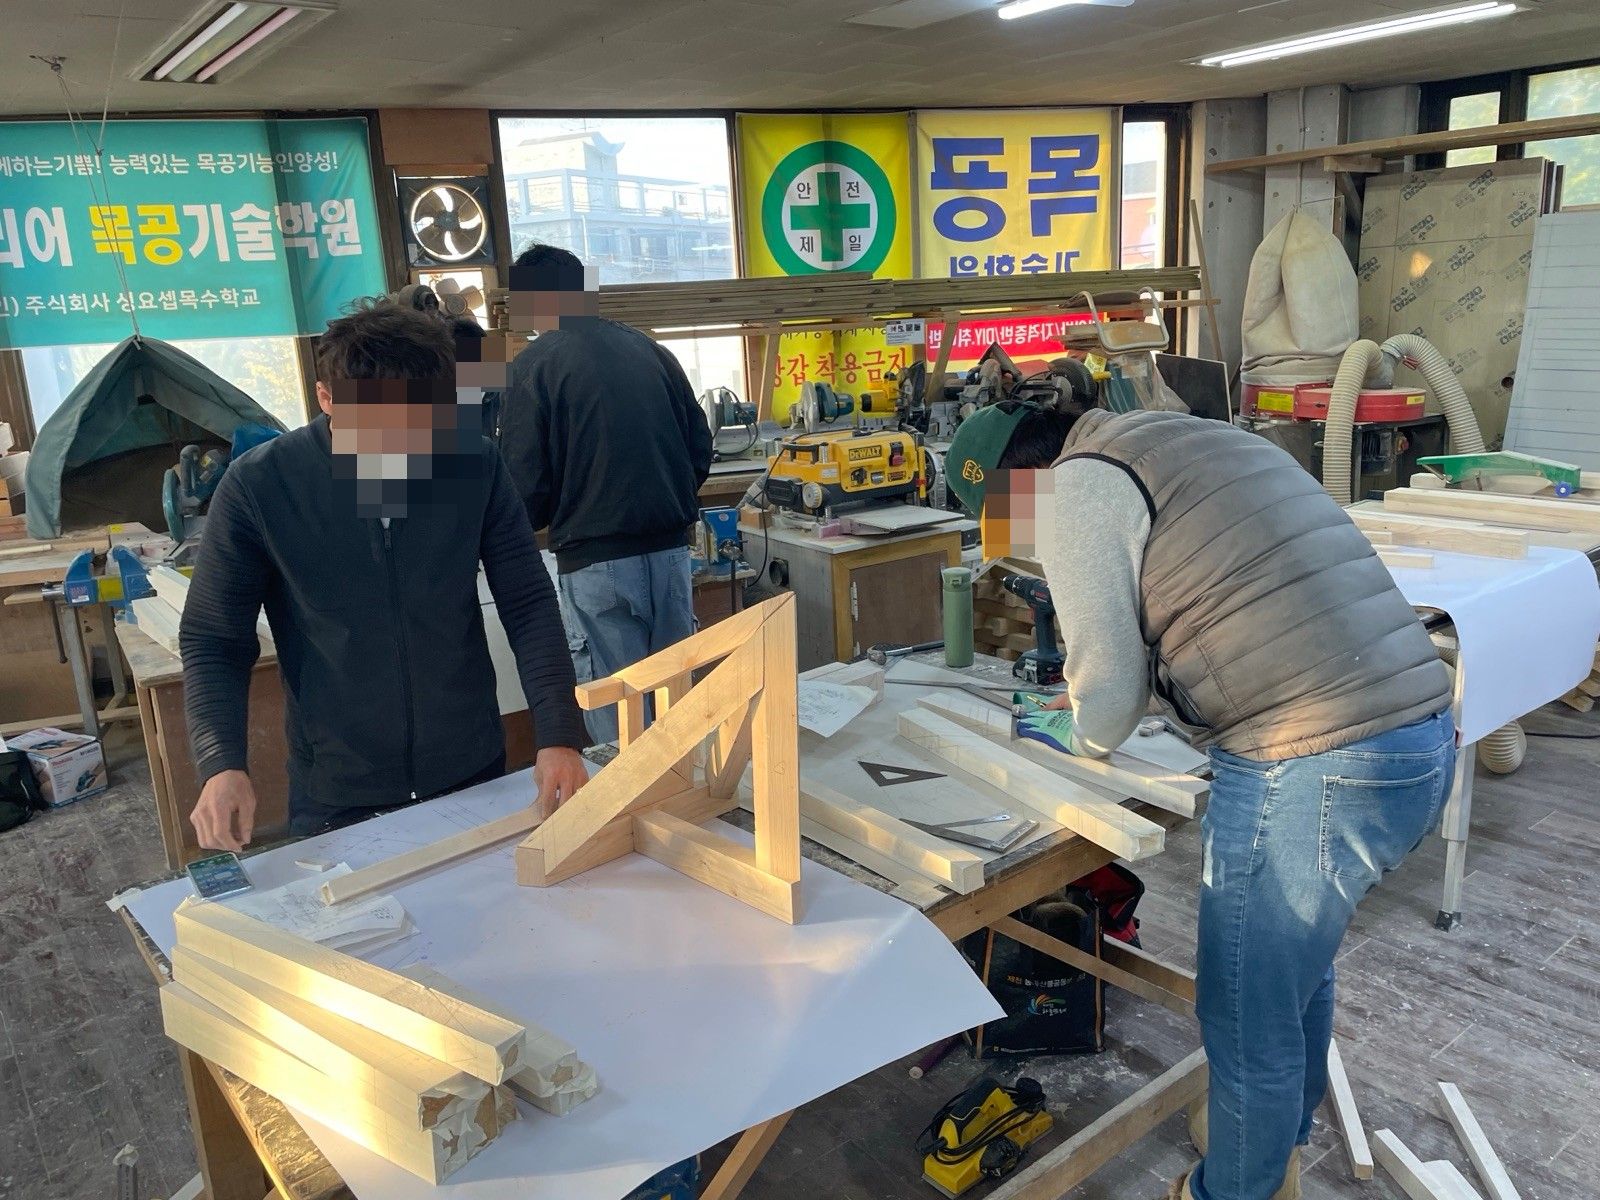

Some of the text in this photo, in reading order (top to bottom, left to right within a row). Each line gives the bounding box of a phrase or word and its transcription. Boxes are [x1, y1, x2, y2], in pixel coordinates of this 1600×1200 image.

[109, 153, 190, 176] 능력있는
[197, 151, 339, 174] 목공기능인양성!
[796, 181, 861, 200] 안 전
[88, 198, 363, 266] 목공기술학원
[799, 234, 862, 254] 제 일
[25, 292, 111, 316] 주식회사
[815, 347, 907, 385] 착용금지
